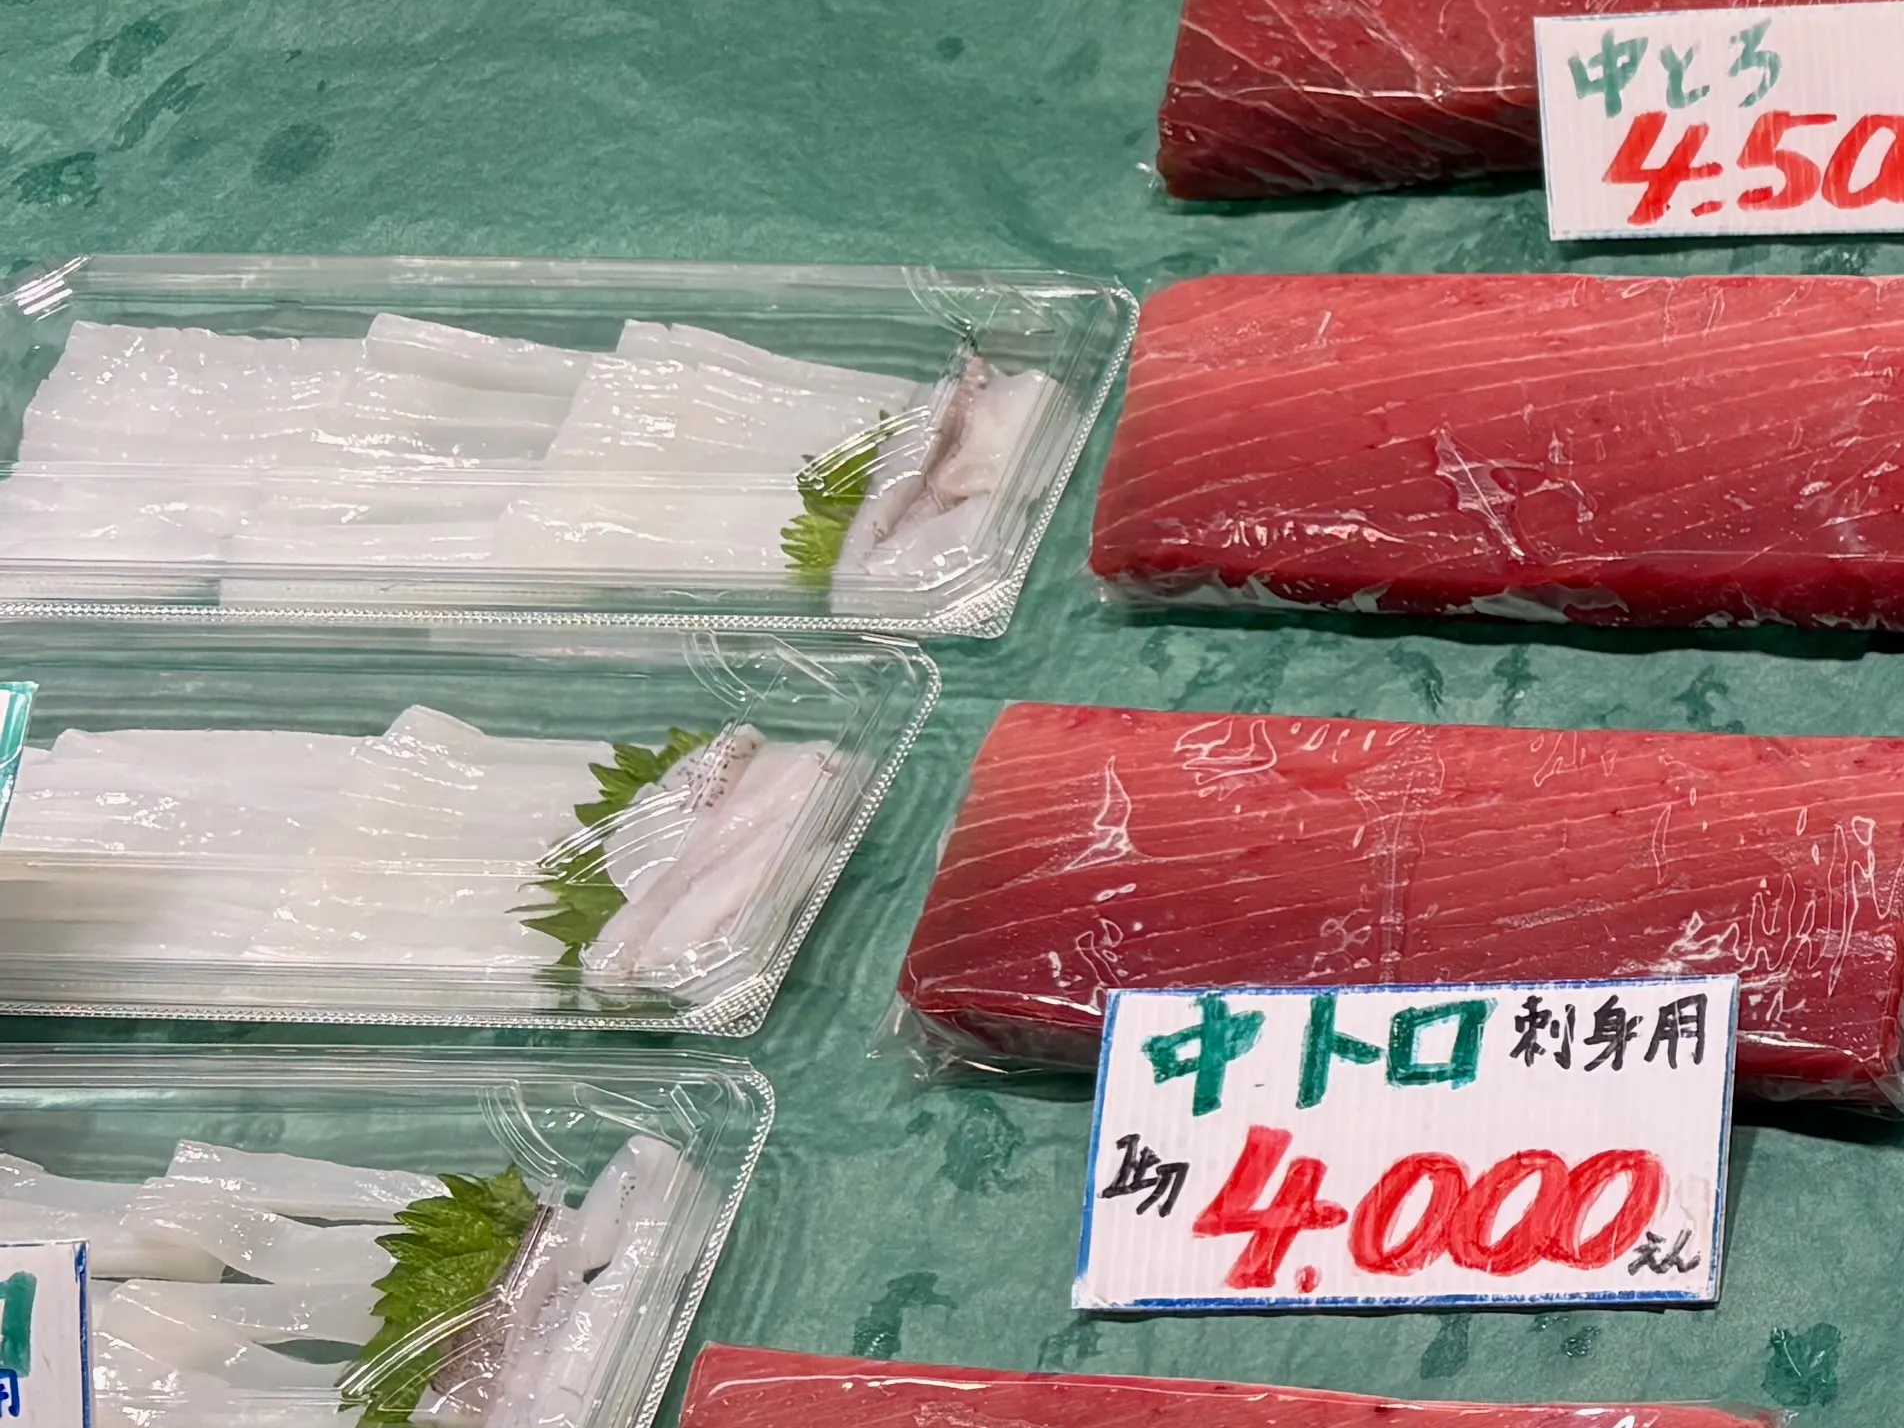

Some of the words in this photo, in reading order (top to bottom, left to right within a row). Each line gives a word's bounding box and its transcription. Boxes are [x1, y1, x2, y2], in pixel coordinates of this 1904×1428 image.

[1568, 19, 1781, 118] 中とろ
[1509, 993, 1708, 1071] 刺身用
[1627, 1228, 1699, 1276] えん
